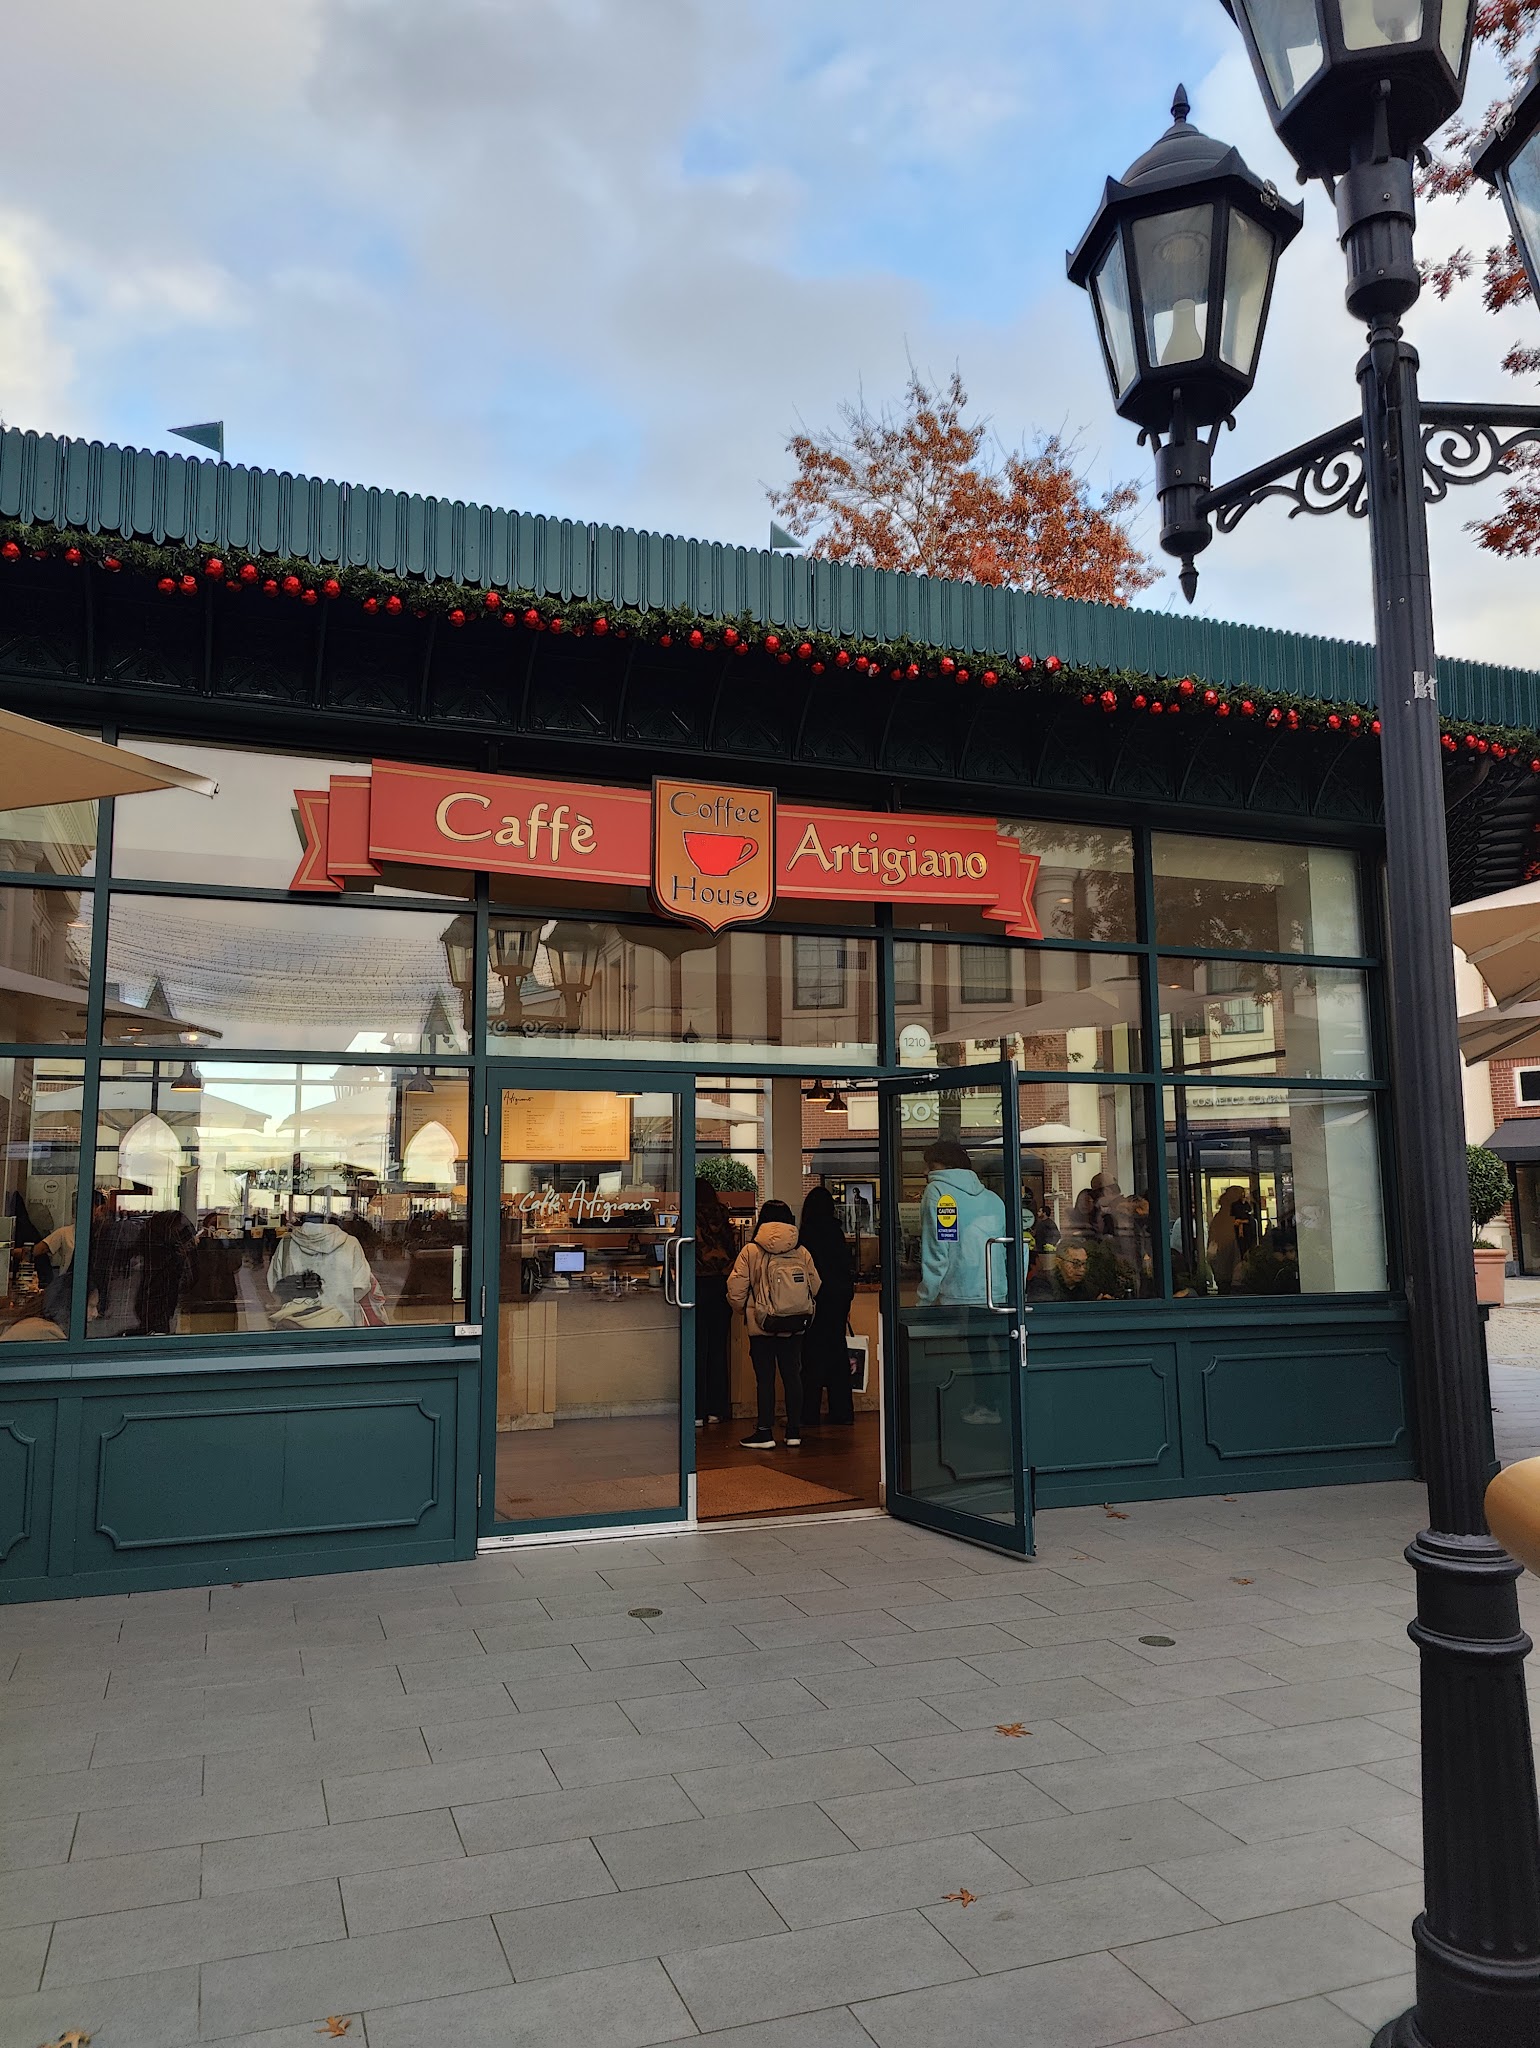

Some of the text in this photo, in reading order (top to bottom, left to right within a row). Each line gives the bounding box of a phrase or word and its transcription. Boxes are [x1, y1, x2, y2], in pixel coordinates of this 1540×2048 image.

[435, 791, 598, 864] Caffè
[669, 791, 761, 828] Coffee
[786, 822, 988, 886] Artigiano
[672, 875, 759, 906] House
[904, 1037, 926, 1048] 1210
[568, 1179, 660, 1224] Artigiano
